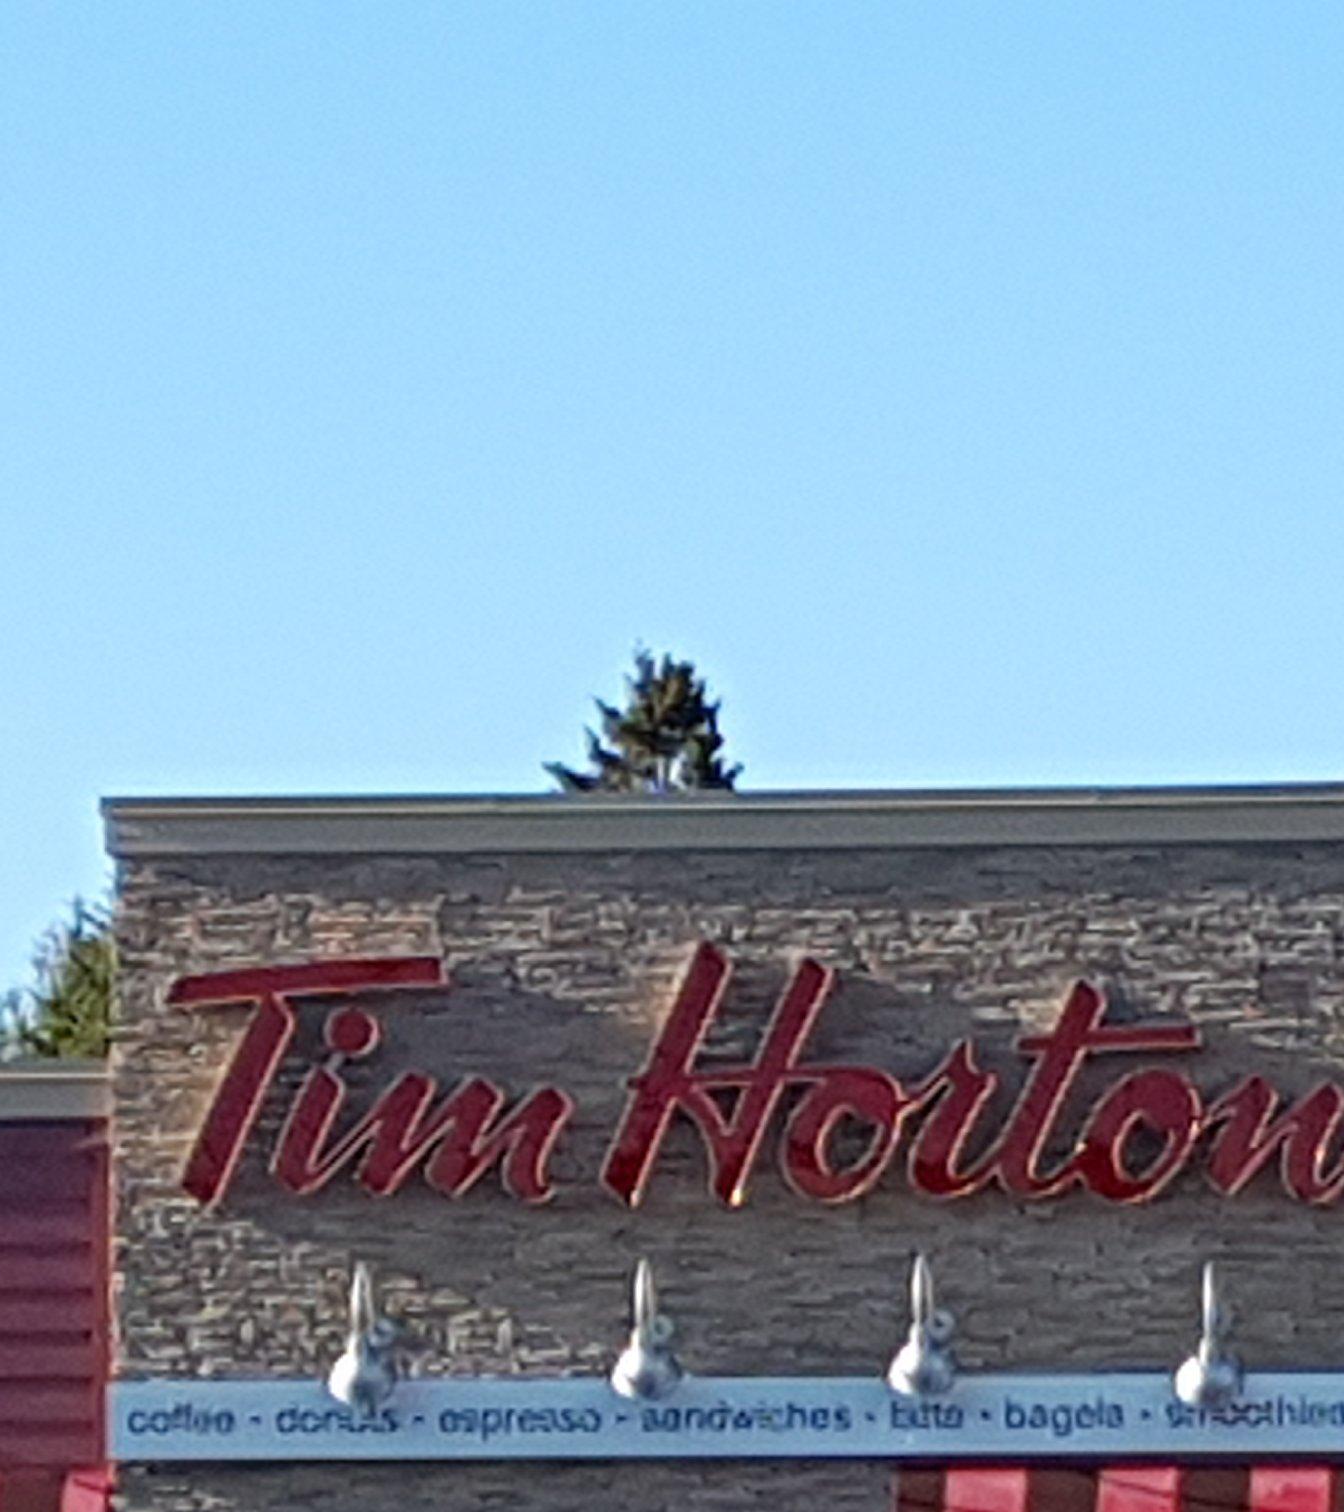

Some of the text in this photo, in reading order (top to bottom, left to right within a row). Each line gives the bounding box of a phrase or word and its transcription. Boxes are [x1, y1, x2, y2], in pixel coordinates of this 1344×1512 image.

[164, 955, 574, 1208] Tim
[127, 1402, 235, 1435] coffee
[275, 1402, 399, 1433] donuts
[439, 1406, 601, 1441] espresso
[641, 1400, 853, 1433] sandwiches
[1003, 1397, 1124, 1437] bagels
